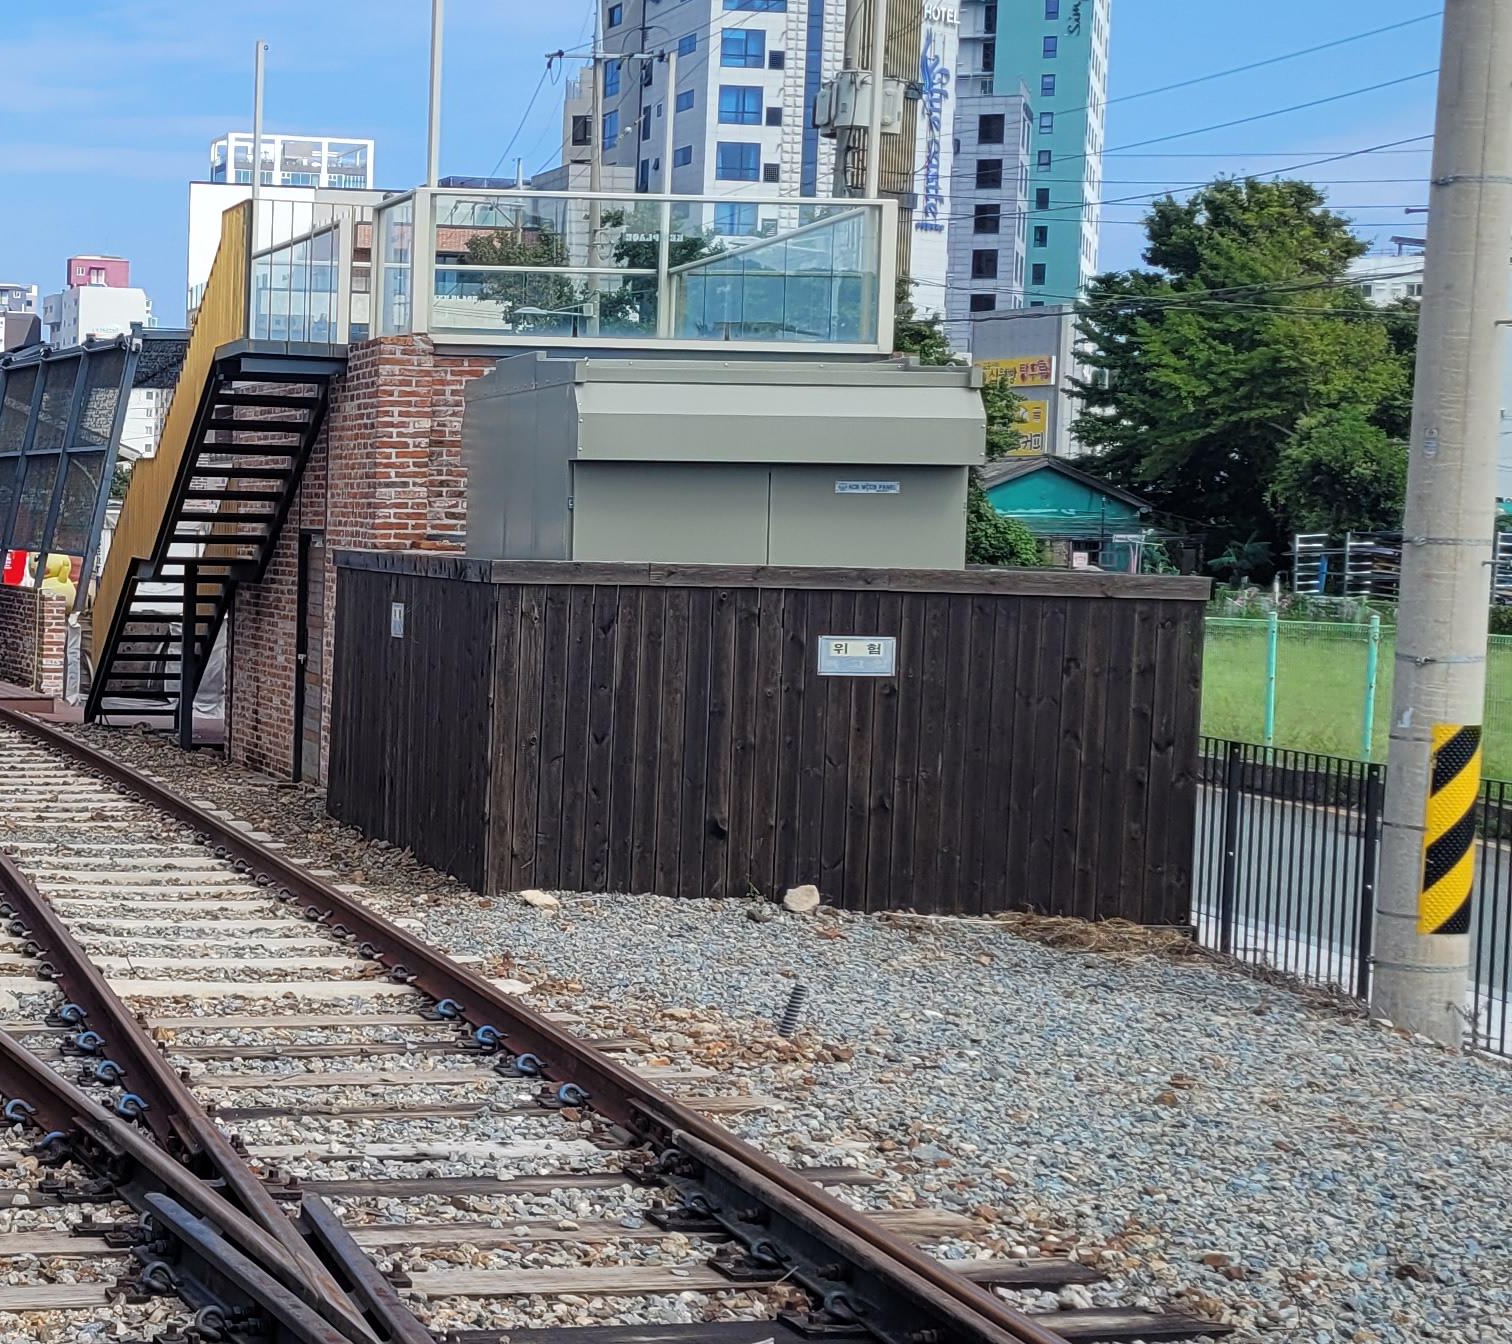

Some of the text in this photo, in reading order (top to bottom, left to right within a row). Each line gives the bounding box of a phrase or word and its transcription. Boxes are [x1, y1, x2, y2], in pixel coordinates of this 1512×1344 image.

[924, 5, 960, 24] HOTEL
[833, 642, 882, 655] 위 험
